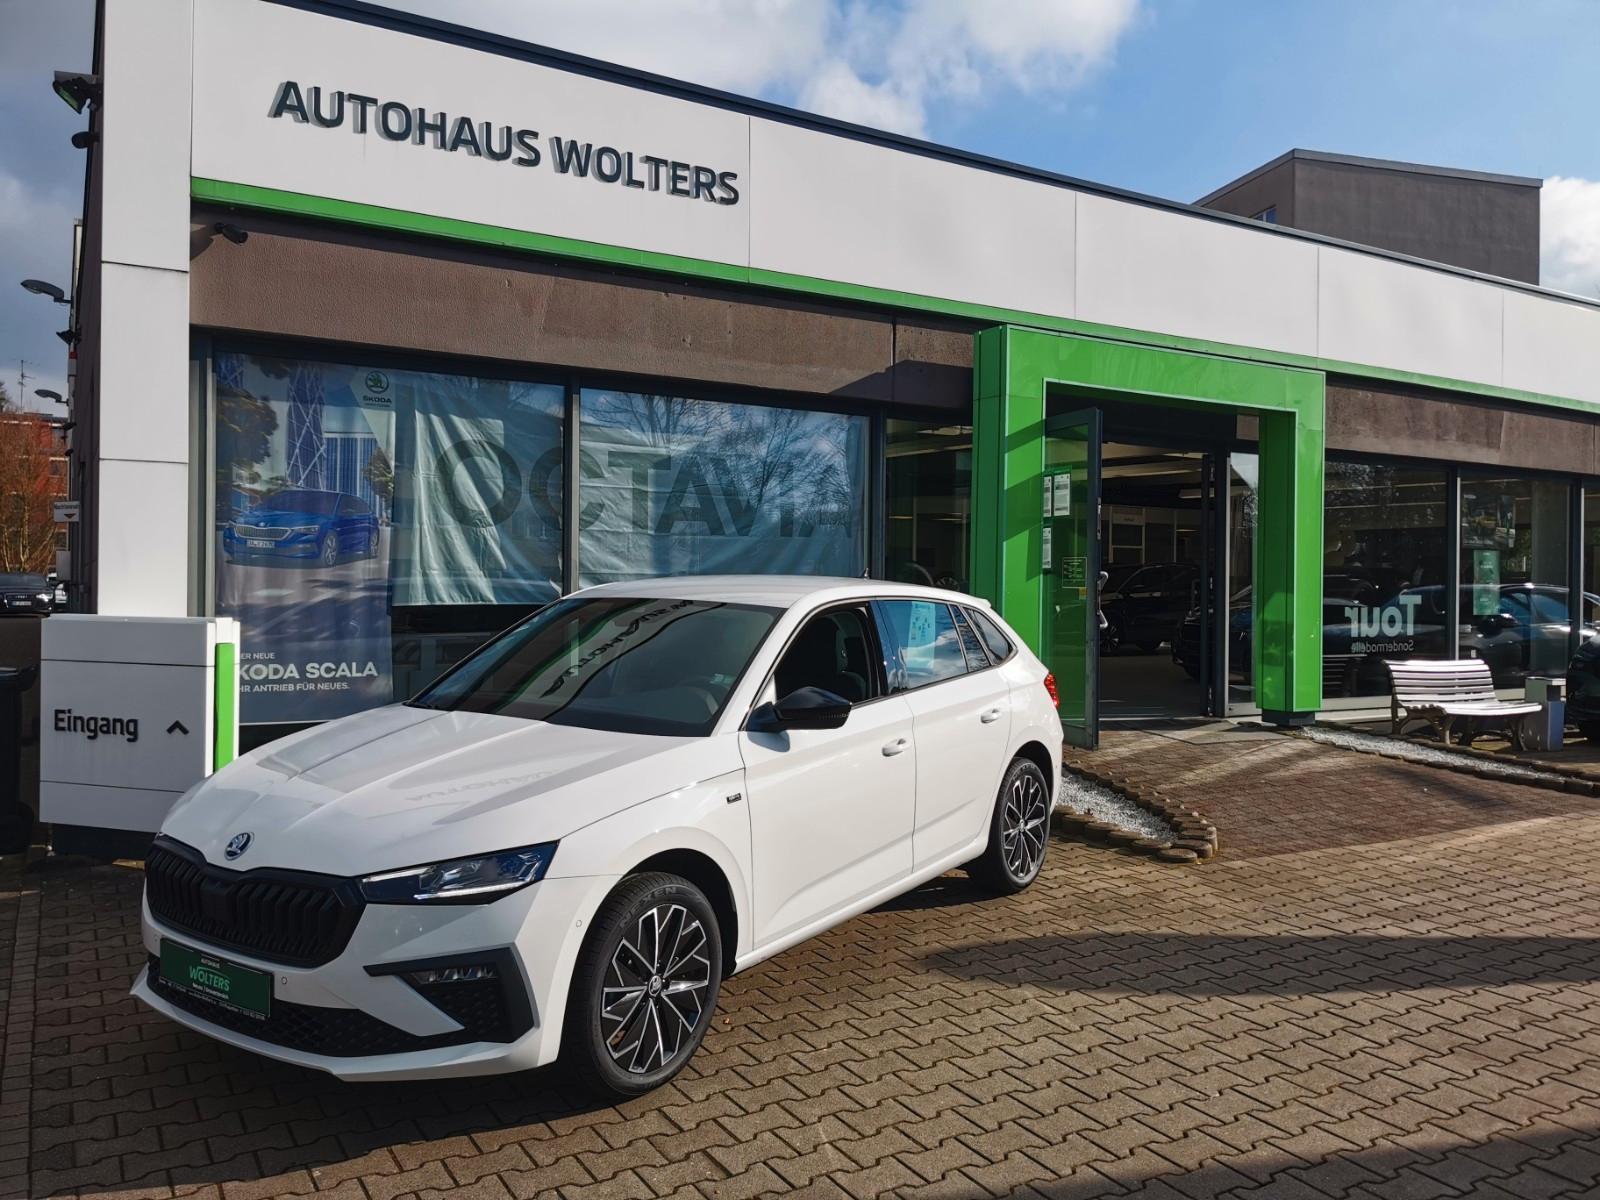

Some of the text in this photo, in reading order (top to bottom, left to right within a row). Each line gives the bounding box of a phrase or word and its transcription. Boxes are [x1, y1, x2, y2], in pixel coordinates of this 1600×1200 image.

[270, 81, 738, 205] AUTOHAUS WOLTERS
[436, 438, 853, 538] OCTAVIA
[253, 652, 276, 660] NEUE
[240, 662, 378, 680] KODA SCALA
[240, 682, 351, 693] HR ANTRIEB FÜR NEUES.
[54, 709, 139, 742] Eingang
[188, 965, 231, 992] WOLTERS
